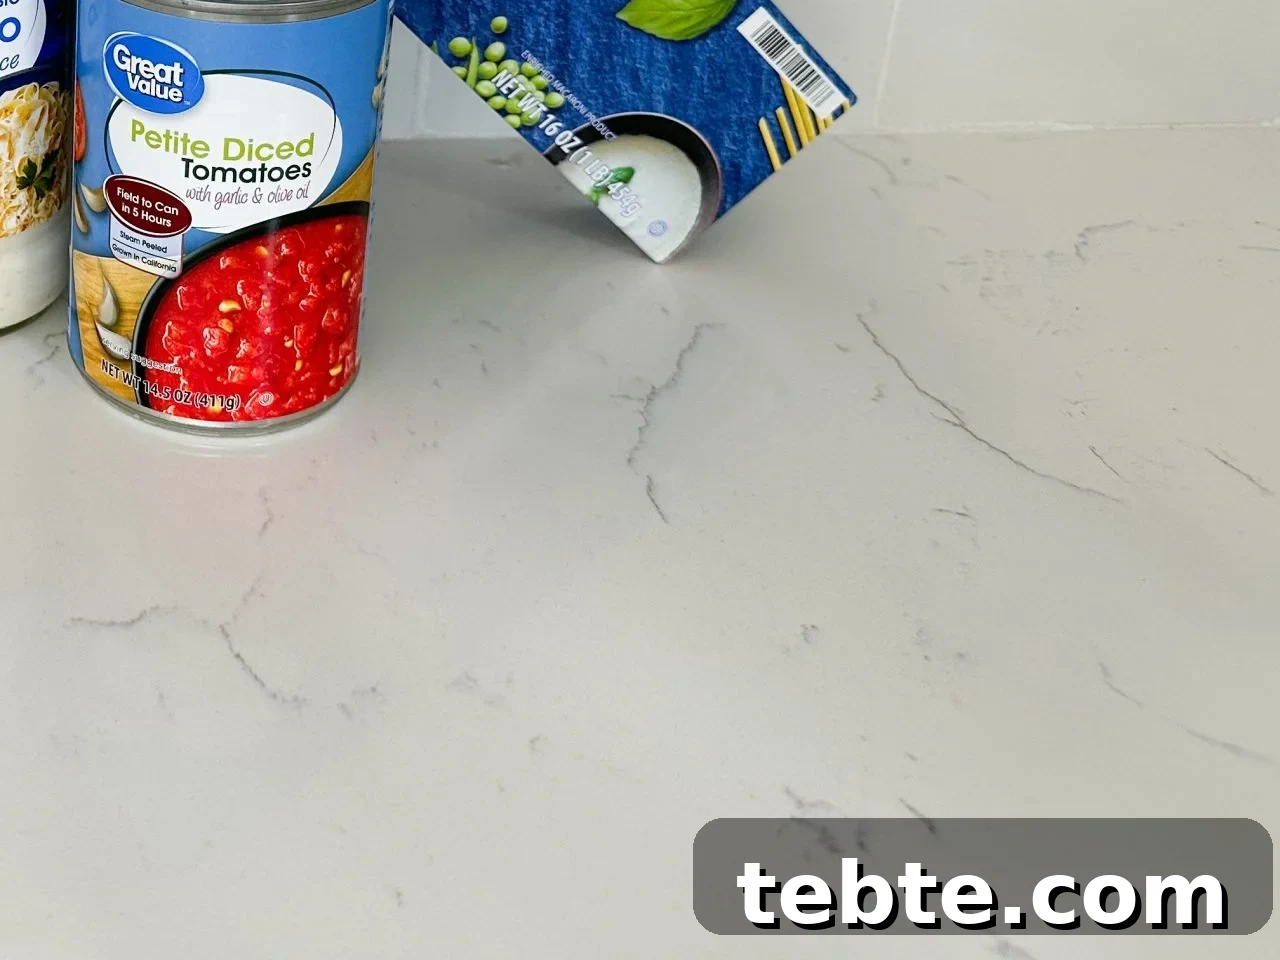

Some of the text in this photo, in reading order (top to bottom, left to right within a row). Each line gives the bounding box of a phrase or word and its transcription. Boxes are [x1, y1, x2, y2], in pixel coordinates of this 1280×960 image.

[112, 43, 184, 87] Great
[126, 72, 183, 103] Value
[521, 49, 617, 142] ENRICHED MACARONI PRODUCT
[131, 119, 315, 161] Petite Diced
[491, 69, 641, 217] NET WT 16 OZ (1 LB) 454g
[181, 157, 312, 184] Tomatoes
[117, 187, 179, 216] Field to Can
[185, 180, 311, 211] with garlic & olive oil
[121, 203, 172, 227] in 5 Hours
[120, 230, 168, 253] Steam Peeled
[112, 243, 133, 259] Grown
[141, 256, 177, 272] California
[131, 353, 183, 375] suggestion
[101, 358, 241, 411] NET WT 14.5 OZ (411g)
